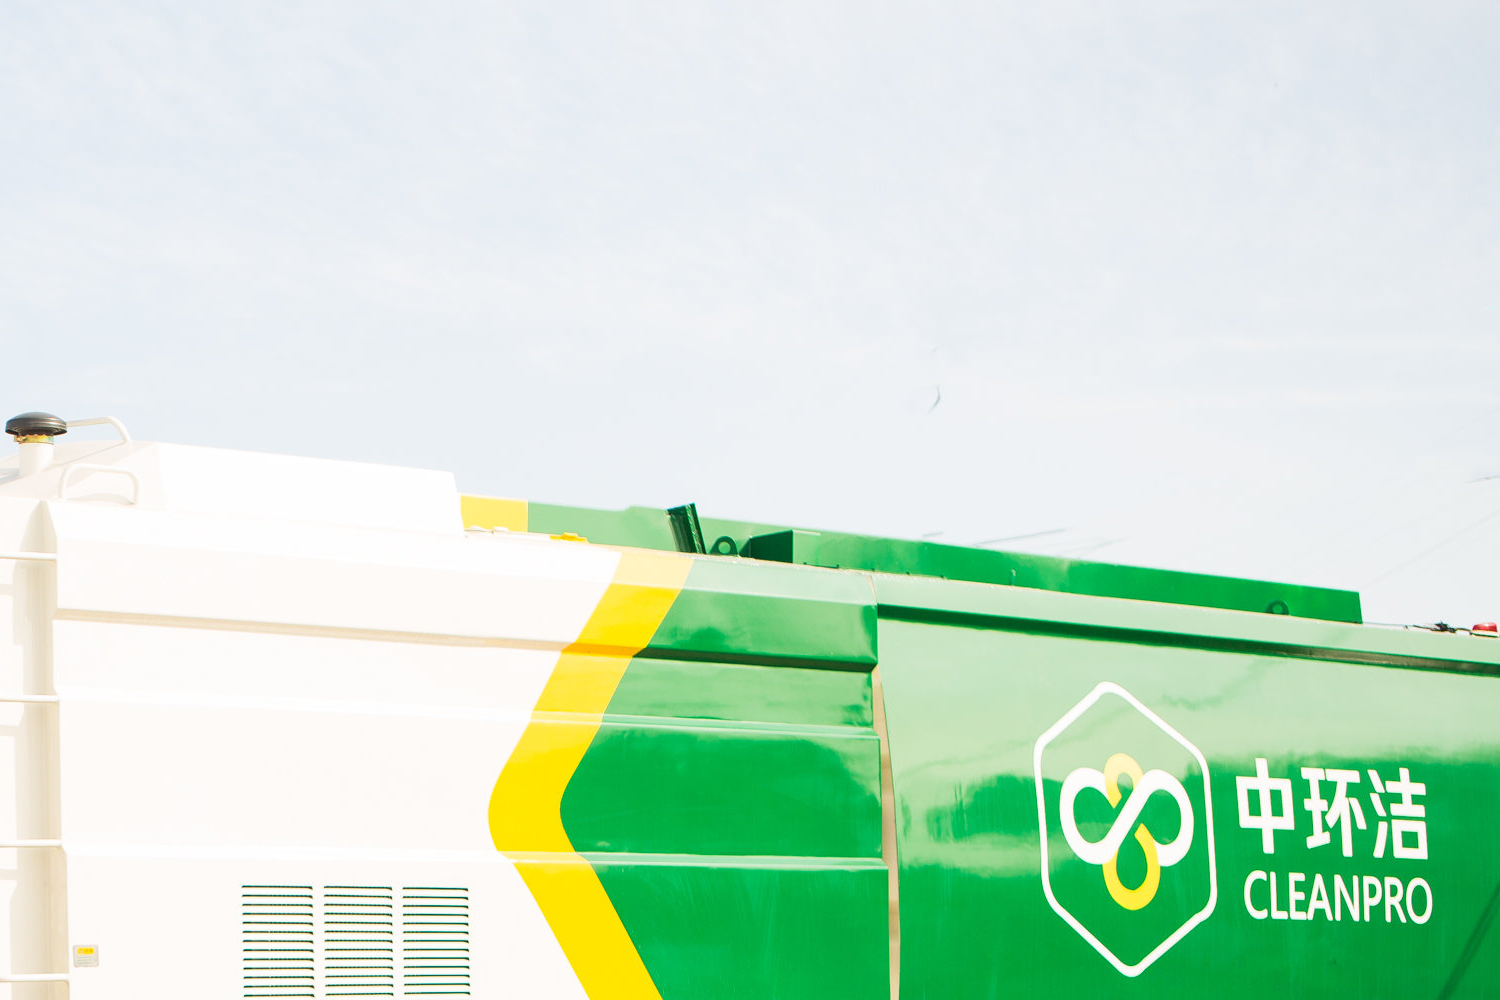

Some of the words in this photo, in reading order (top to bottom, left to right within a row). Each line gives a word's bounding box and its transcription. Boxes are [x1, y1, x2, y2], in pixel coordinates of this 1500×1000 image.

[1235, 757, 1429, 860] 中环洁
[1243, 869, 1433, 925] CLEANPRO
